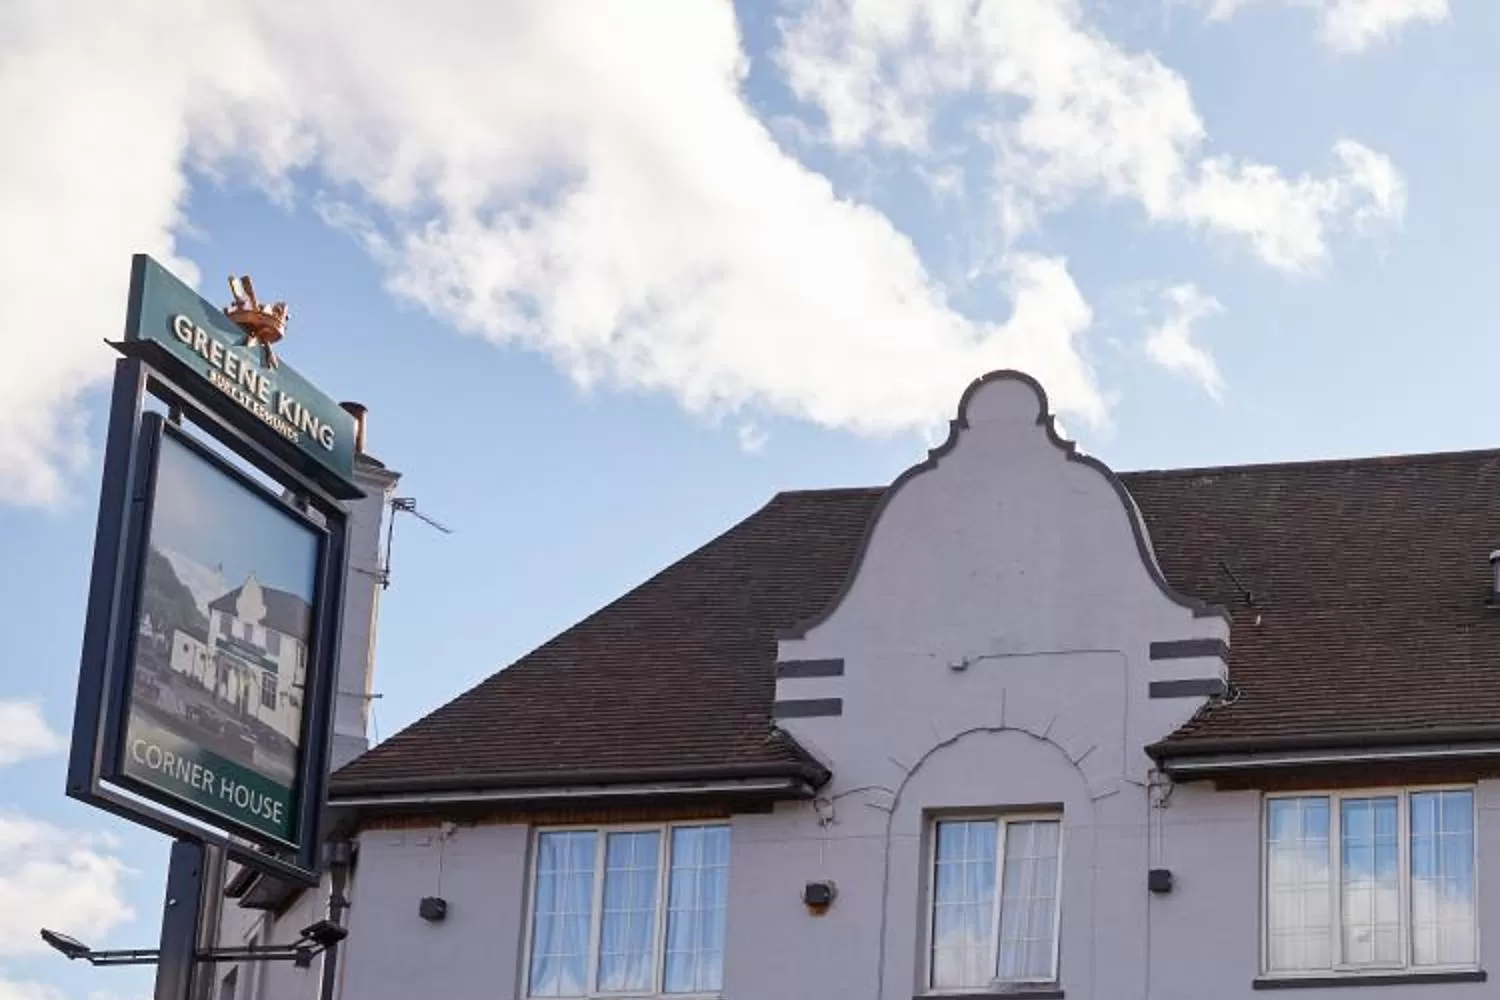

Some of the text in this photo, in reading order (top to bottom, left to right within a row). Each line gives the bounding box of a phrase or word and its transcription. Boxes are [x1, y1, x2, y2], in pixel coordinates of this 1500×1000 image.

[173, 314, 335, 450] GREENE KING
[132, 738, 283, 824] CORNER HOUSE
